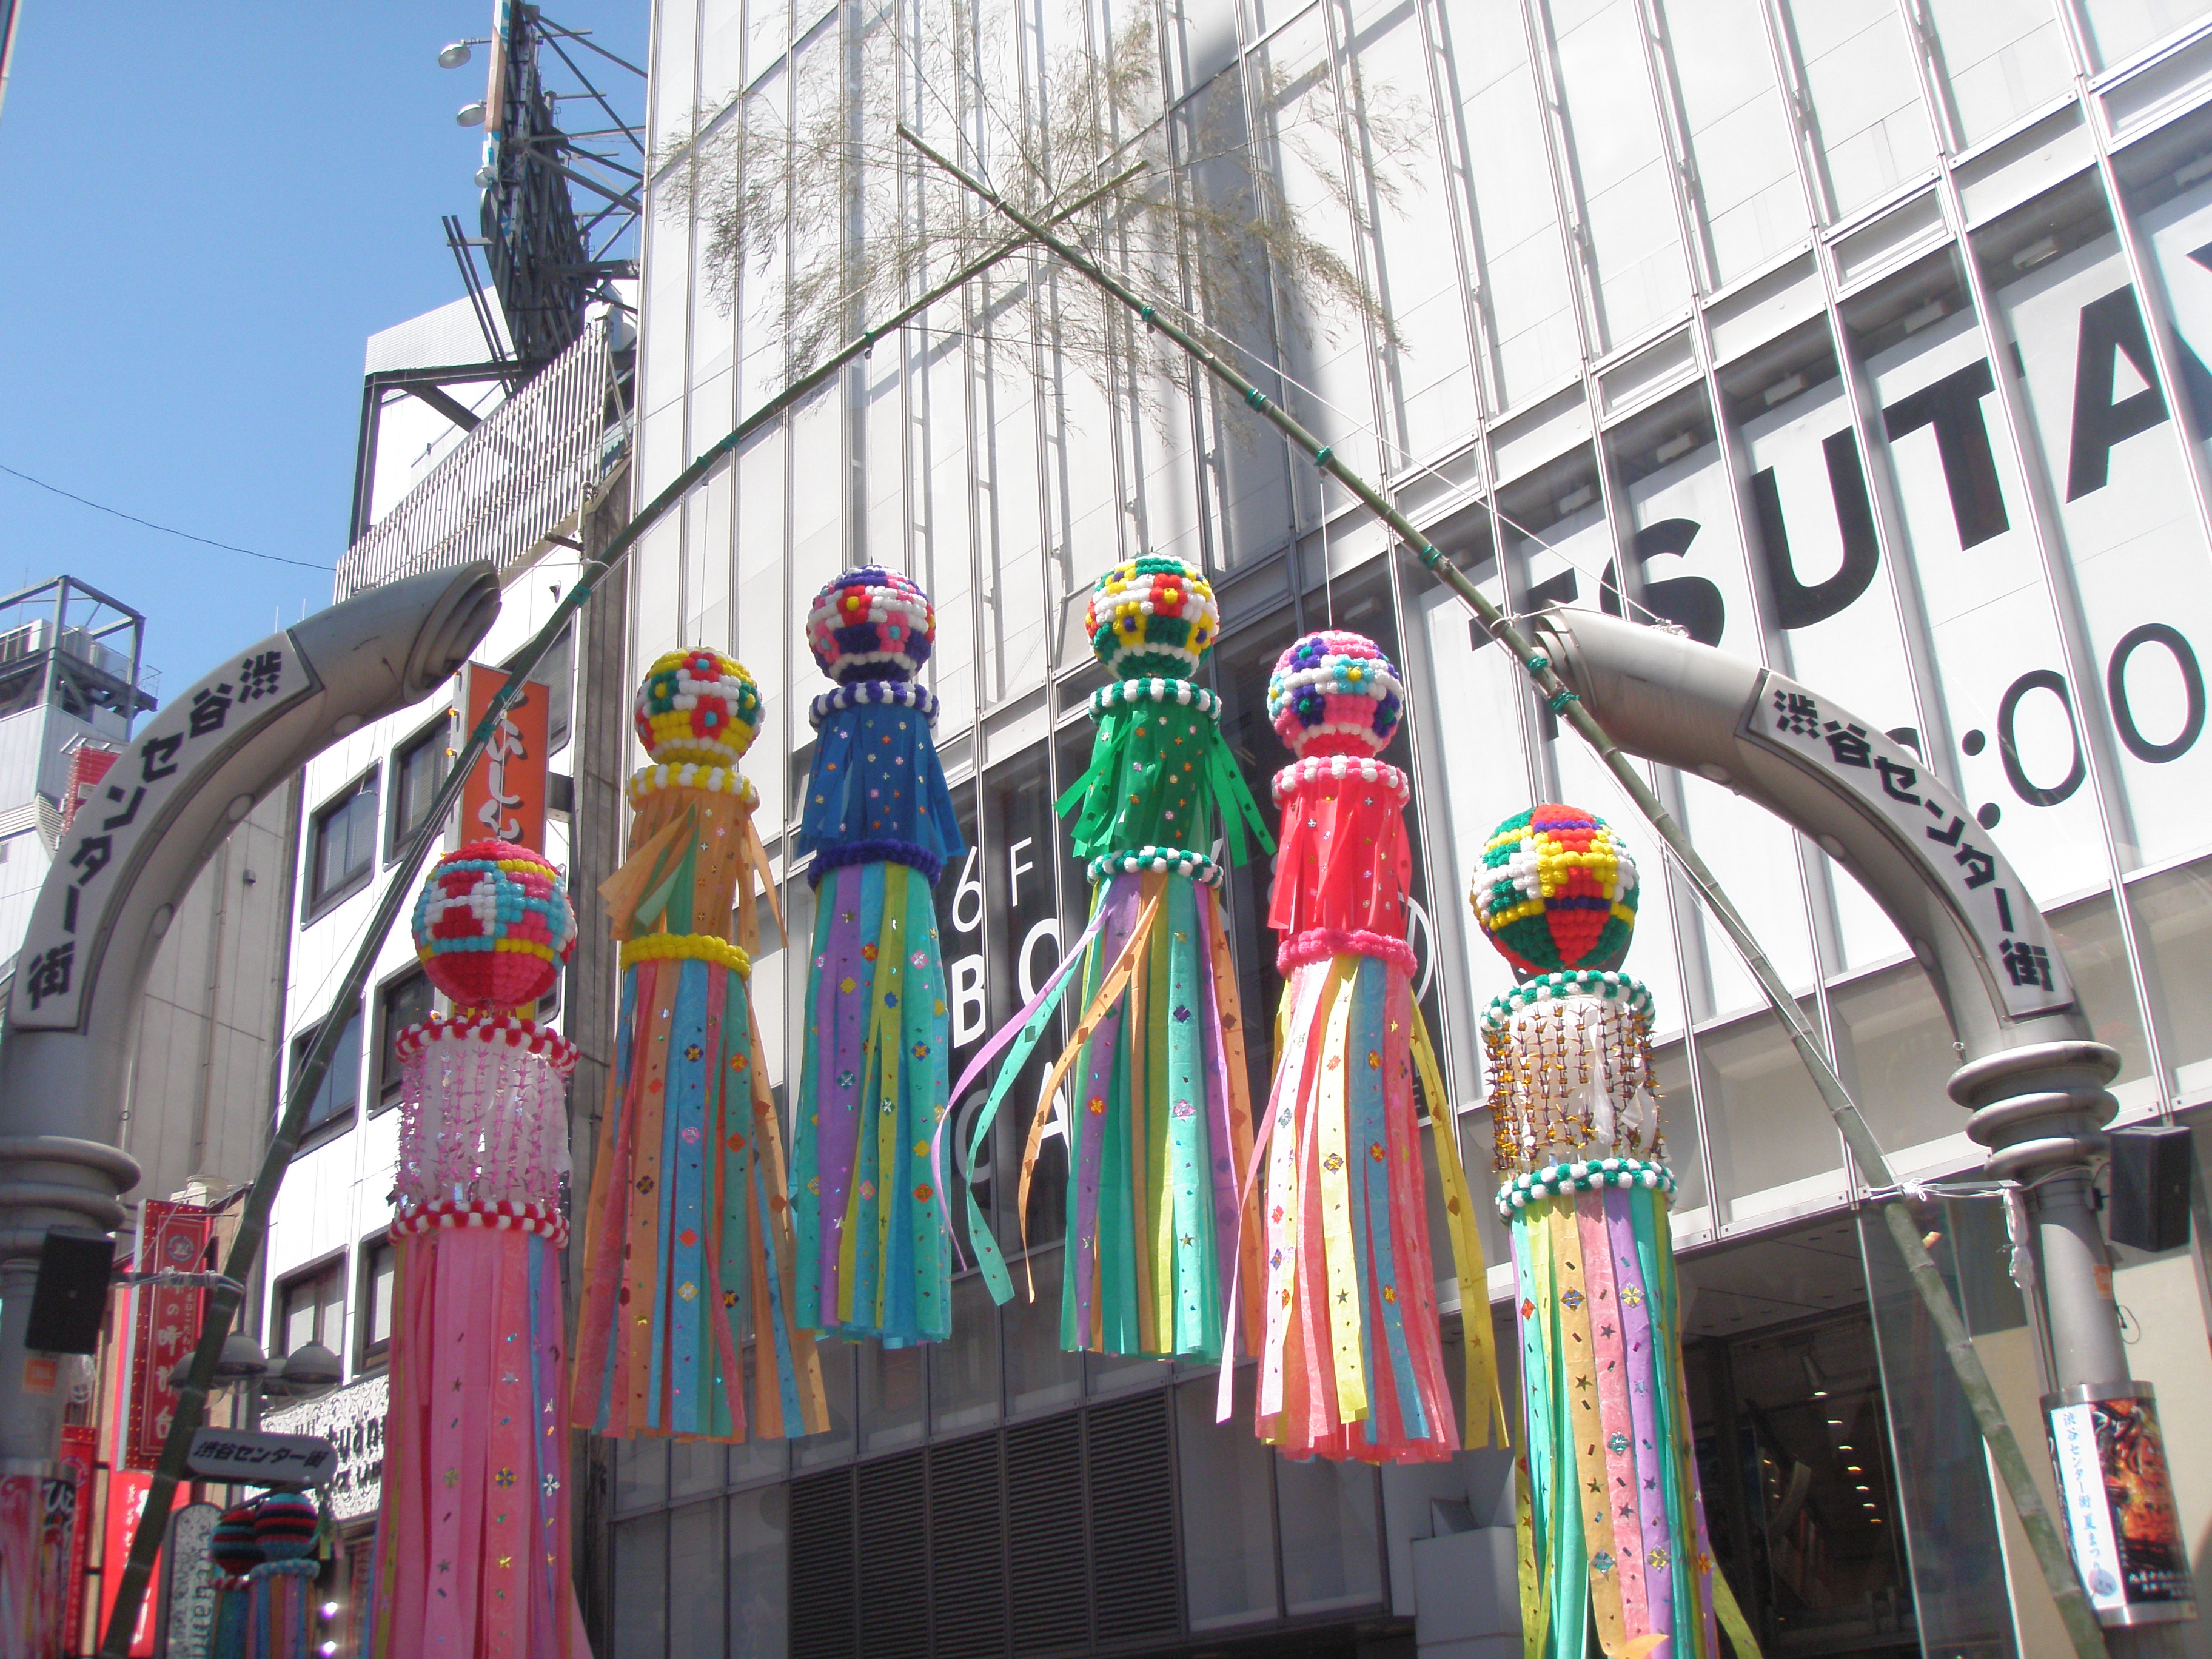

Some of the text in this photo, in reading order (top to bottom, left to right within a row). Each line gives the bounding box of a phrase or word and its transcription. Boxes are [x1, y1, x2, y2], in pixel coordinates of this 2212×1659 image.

[27, 651, 282, 1010] 渋谷センター街
[1774, 689, 2055, 993] 渋谷センター街
[194, 1440, 330, 1469] 渋谷センター街
